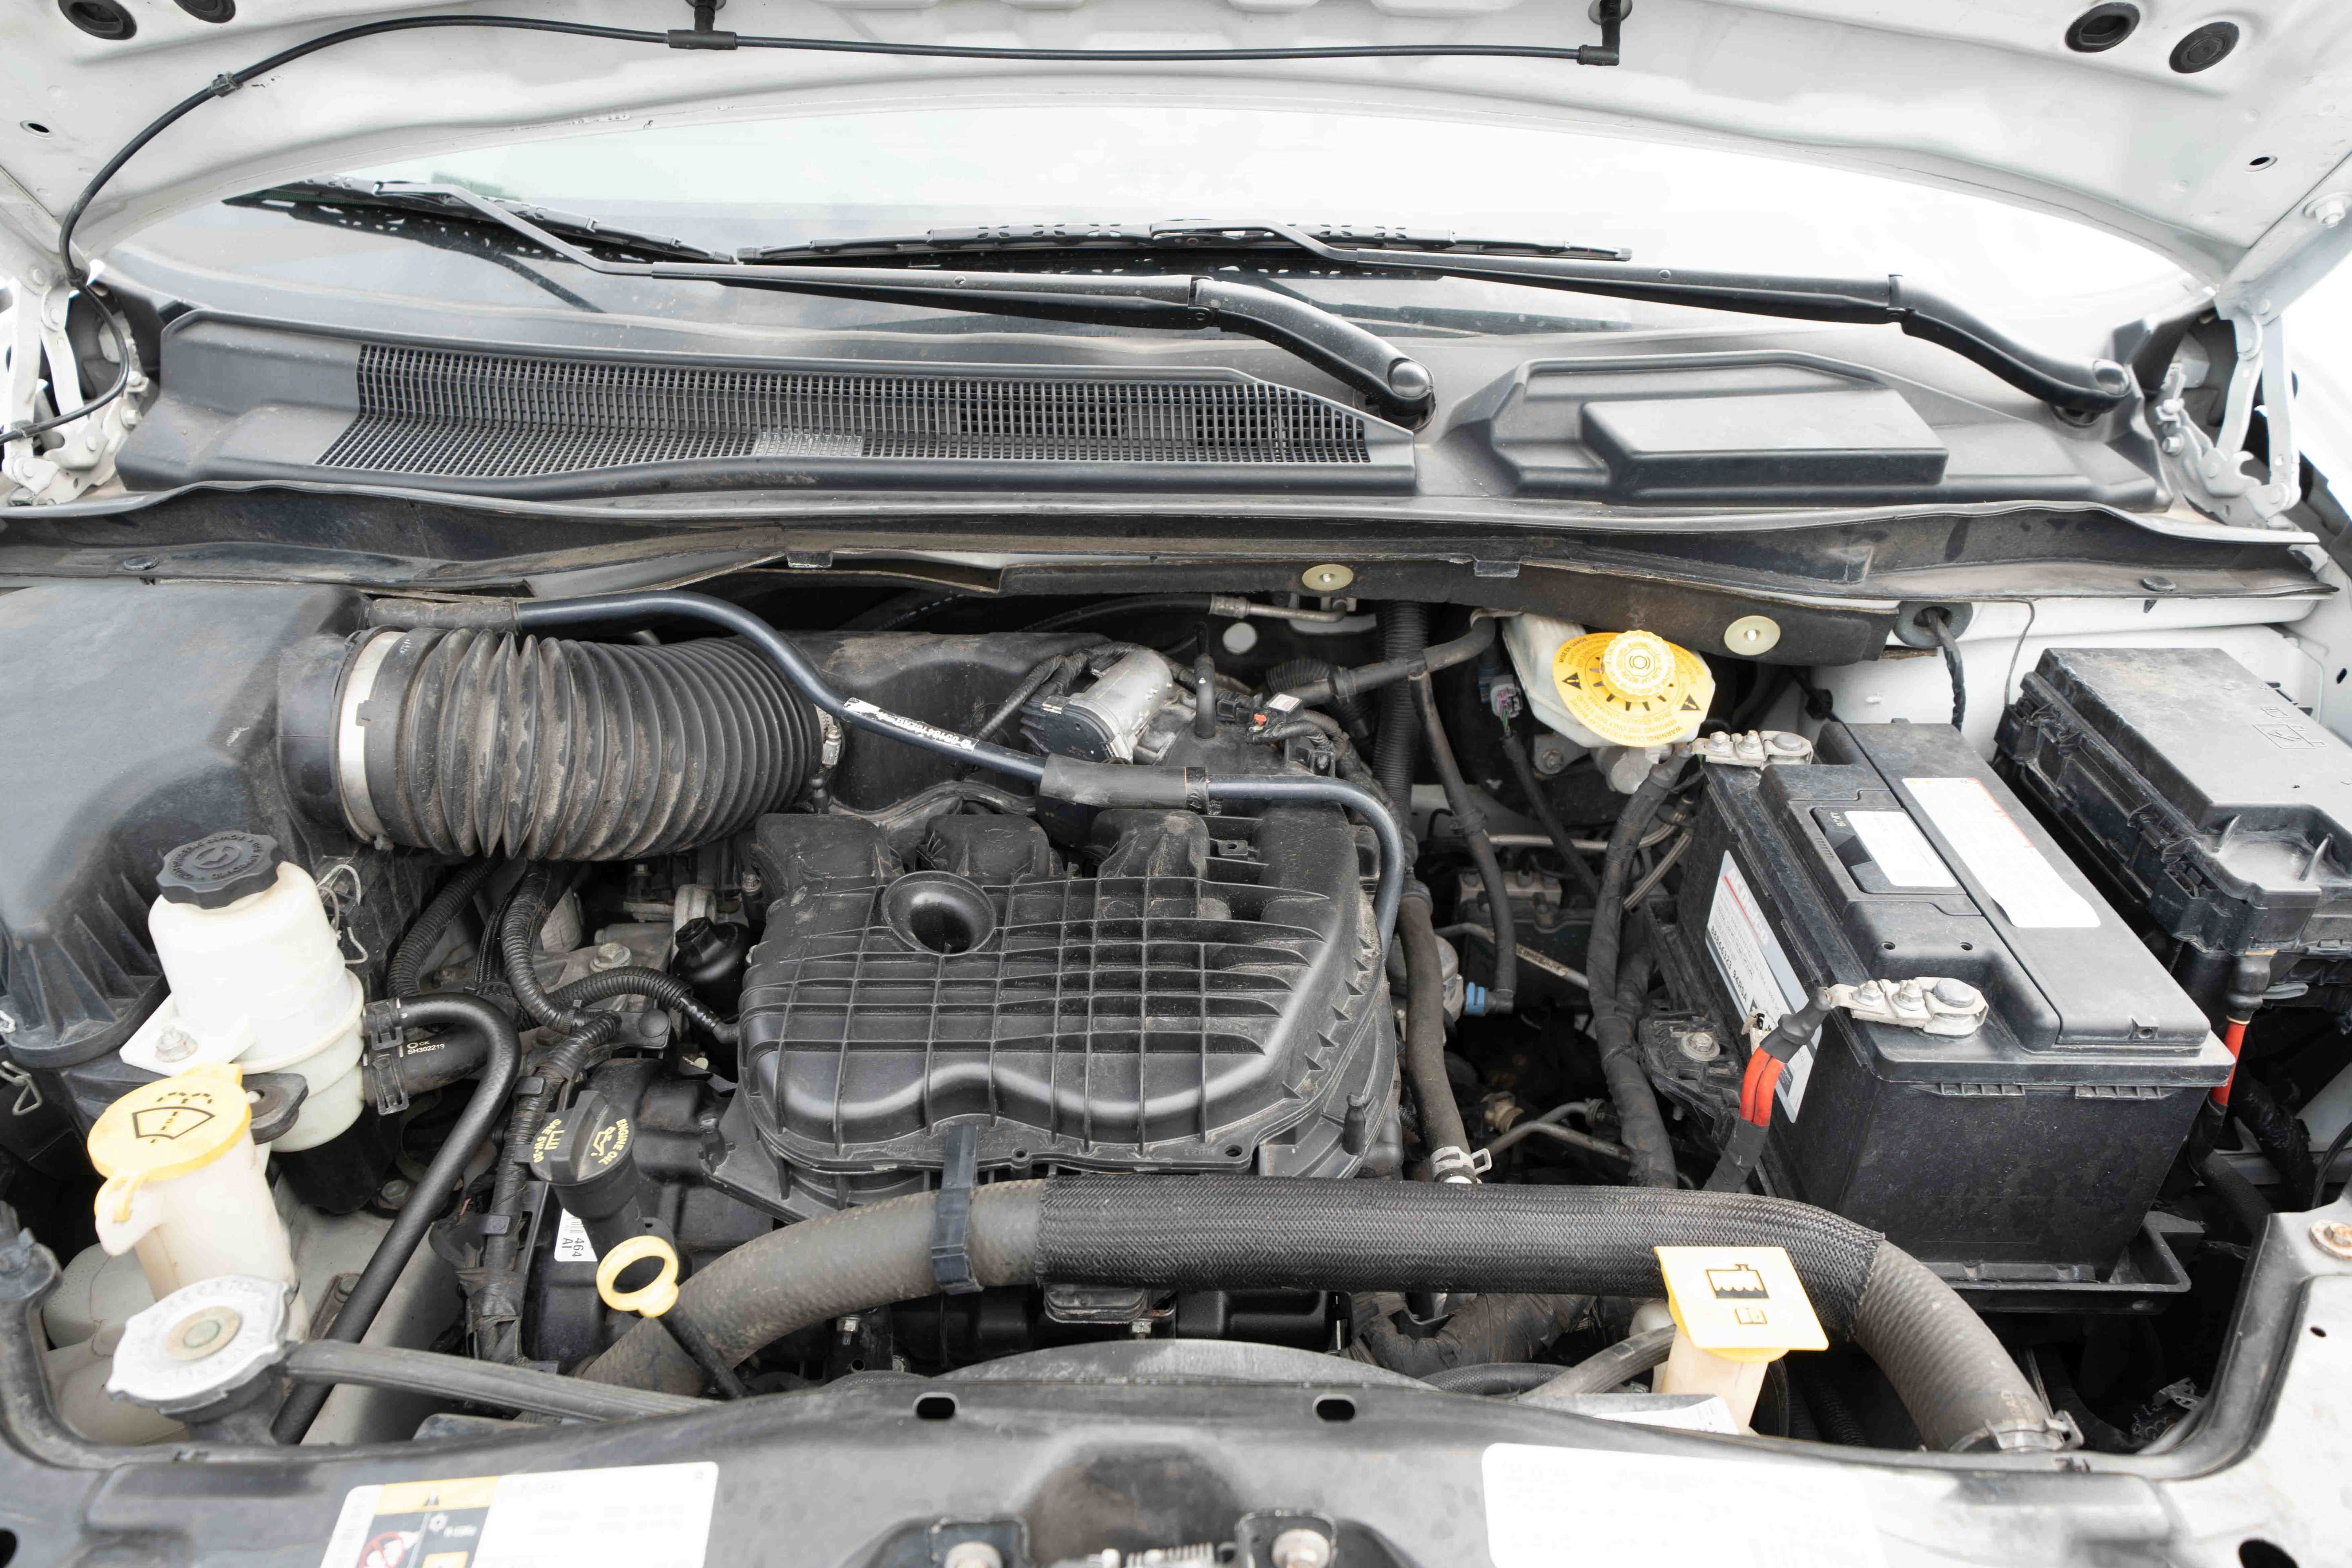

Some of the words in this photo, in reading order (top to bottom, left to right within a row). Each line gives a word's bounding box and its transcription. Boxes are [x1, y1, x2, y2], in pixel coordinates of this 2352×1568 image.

[1559, 651, 1567, 663] MISE
[1727, 867, 1769, 945] ACDelco
[407, 1043, 445, 1055] SH302219
[541, 1118, 562, 1136] SAE
[612, 1118, 630, 1151] ENGINE
[532, 1136, 548, 1163] 5W-20
[597, 1151, 618, 1165] OIL
[572, 1238, 585, 1258] 464
